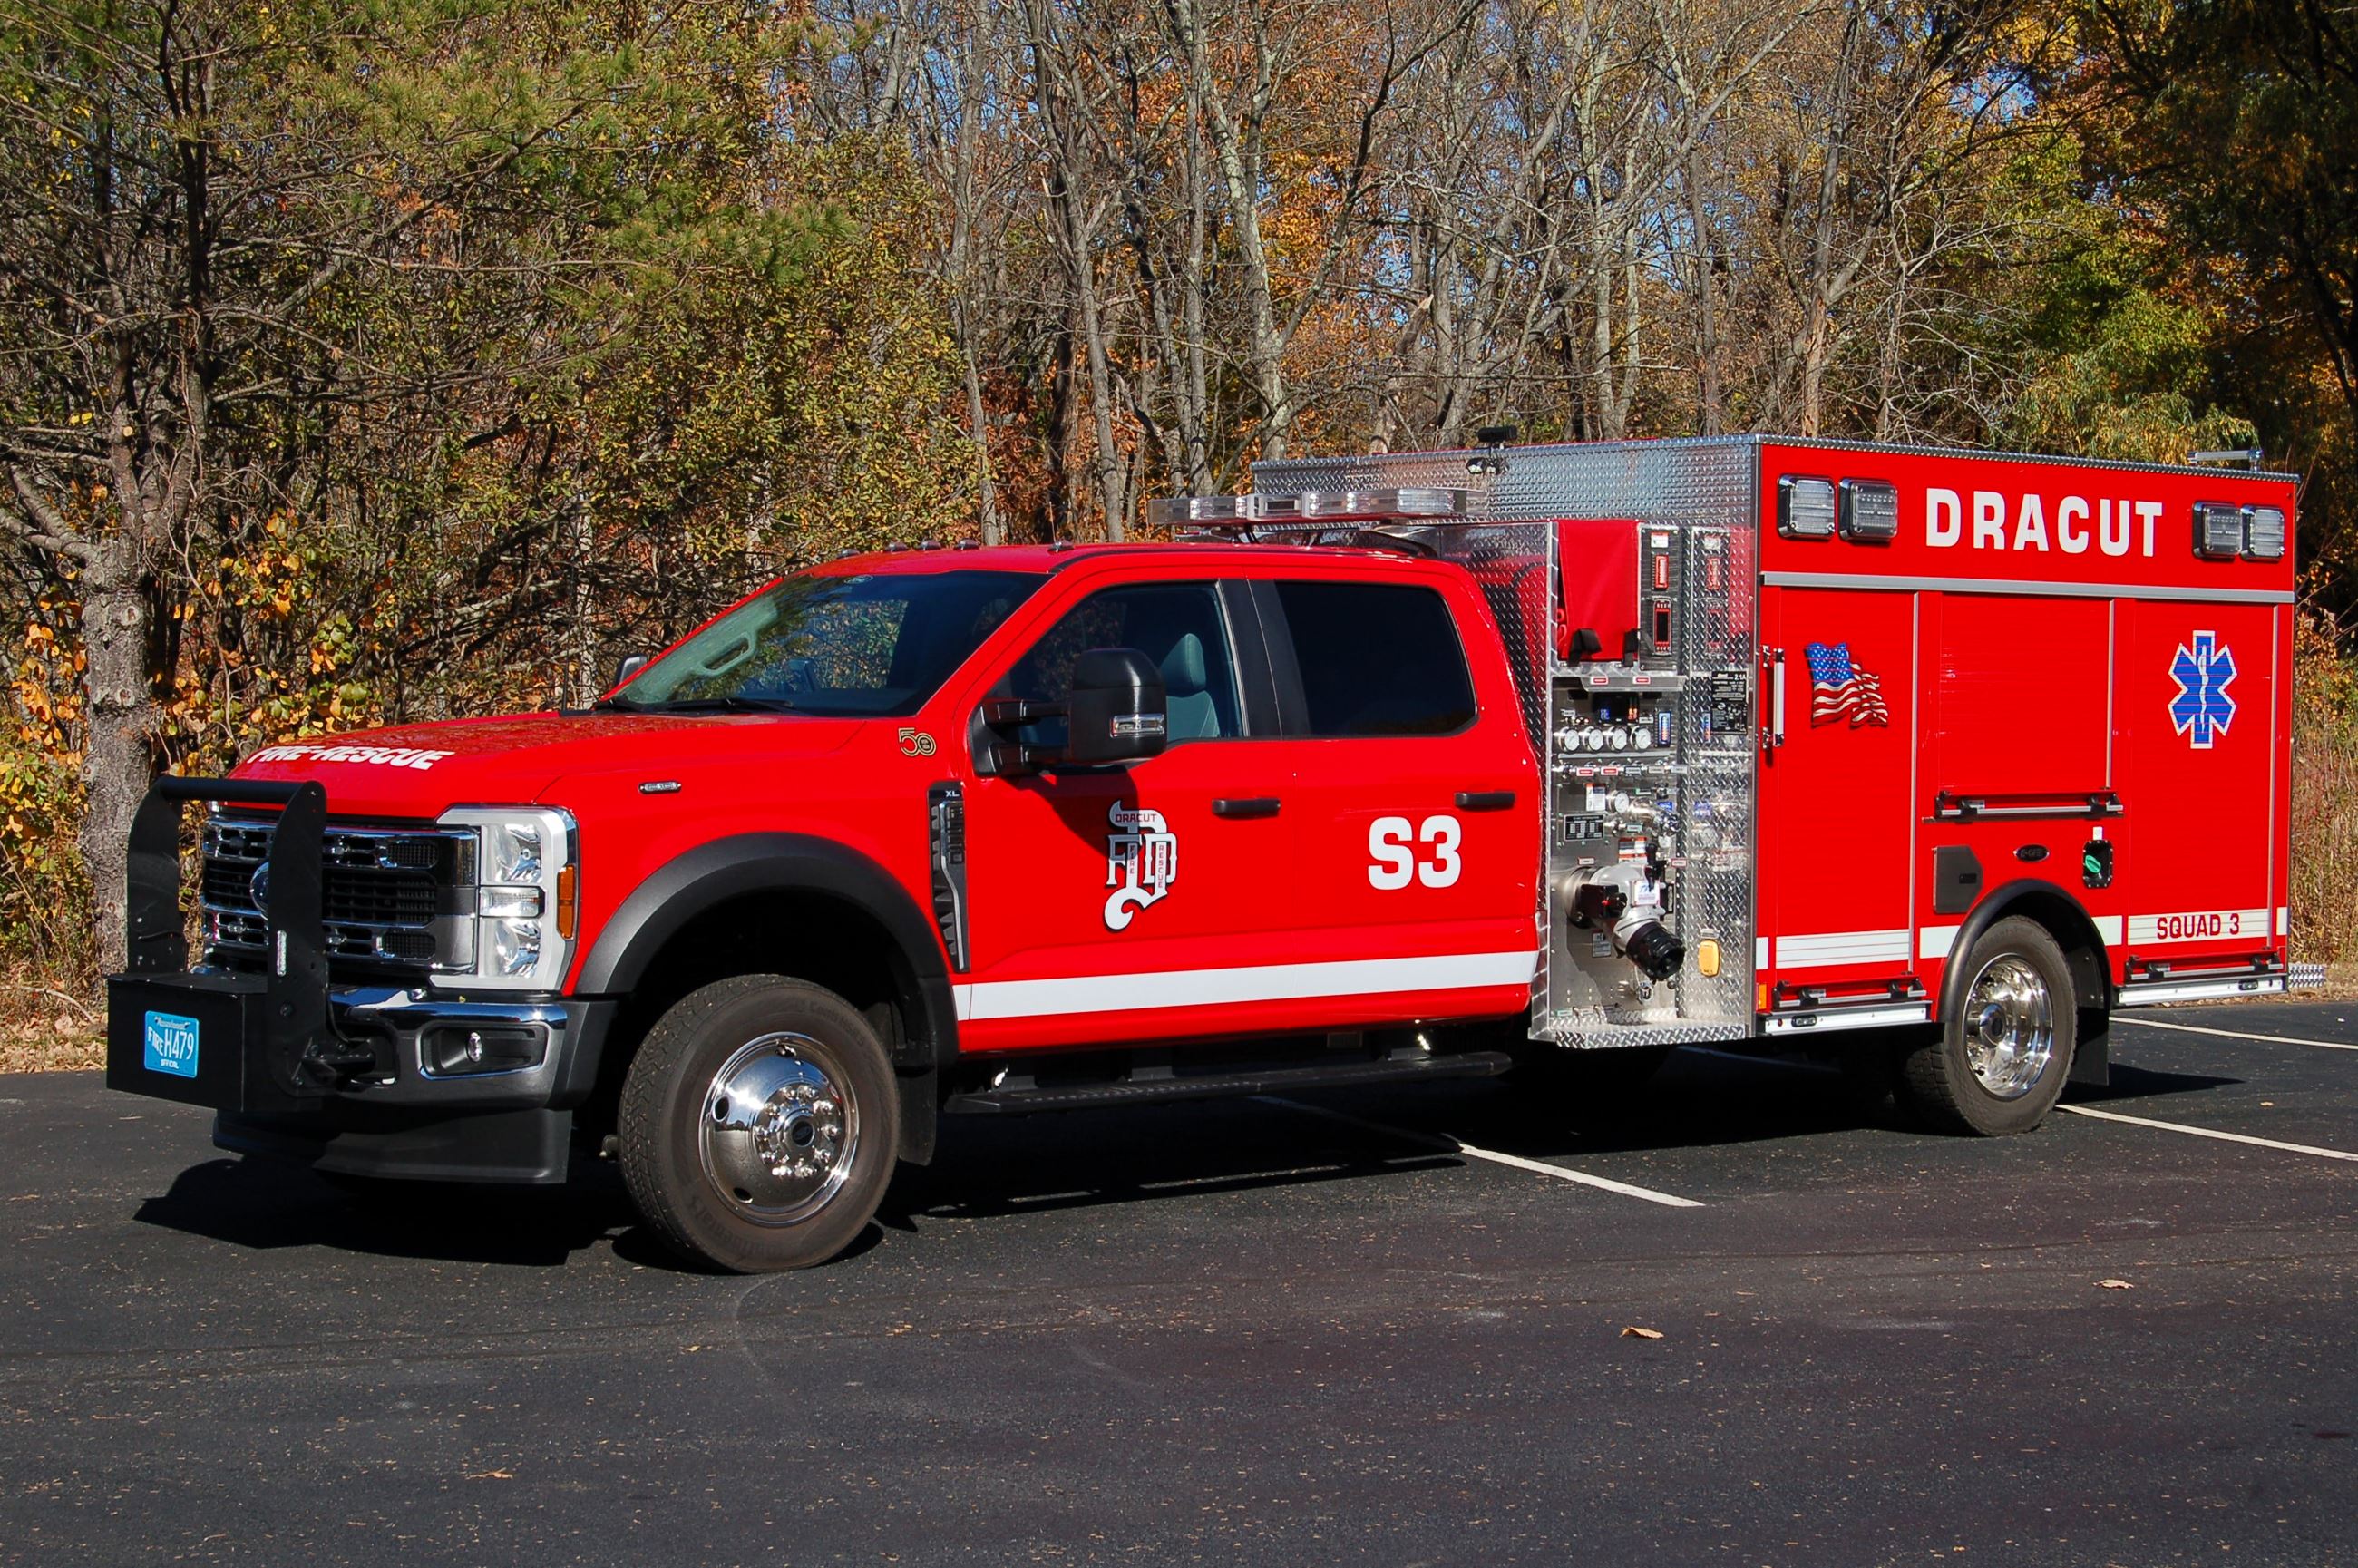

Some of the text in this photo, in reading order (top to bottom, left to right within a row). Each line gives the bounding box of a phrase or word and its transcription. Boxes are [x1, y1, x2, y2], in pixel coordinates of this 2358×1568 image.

[1925, 487, 2163, 558] DRACUT
[899, 727, 937, 757] 50
[247, 745, 455, 771] FIRE-RESCUE
[1115, 813, 1157, 823] DRACUT
[1129, 845, 1137, 874] FIRE
[1368, 814, 1462, 891] S3
[2157, 913, 2240, 940] SQUAD 3
[148, 1026, 195, 1060] FIRE H479
